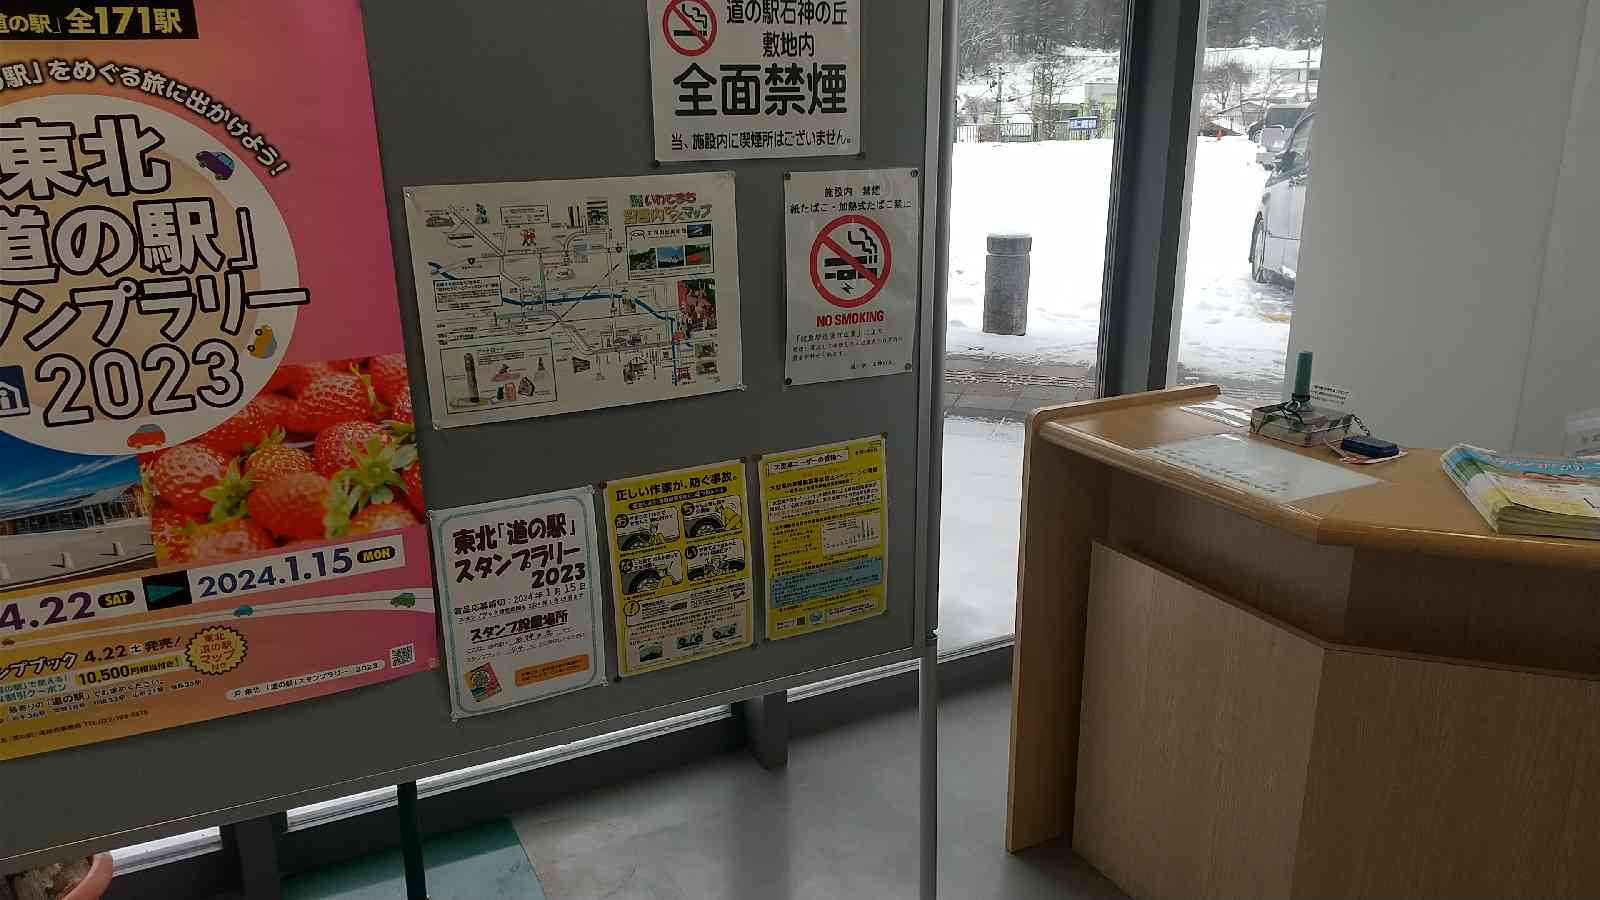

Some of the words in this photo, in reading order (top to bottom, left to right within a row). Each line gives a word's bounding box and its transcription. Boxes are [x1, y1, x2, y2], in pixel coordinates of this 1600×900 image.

[727, 0, 848, 26] 道の駅石神の丘
[762, 32, 815, 57] 敷地内
[672, 62, 848, 116] 全面禁煙
[0, 114, 171, 200] 東北
[671, 129, 851, 151] 当、施設内に喫煙所はございません。
[816, 315, 833, 327] NO
[834, 310, 884, 325] SMOKING
[35, 338, 245, 428] 2023
[452, 512, 577, 556] 東北「道の駅」
[103, 595, 132, 607] SAT
[197, 546, 355, 599] 2024.1.15
[361, 550, 393, 563] MON
[454, 541, 582, 584] スタンプラリー
[530, 562, 586, 589] 2023
[470, 608, 569, 642] スタンプ設置場所
